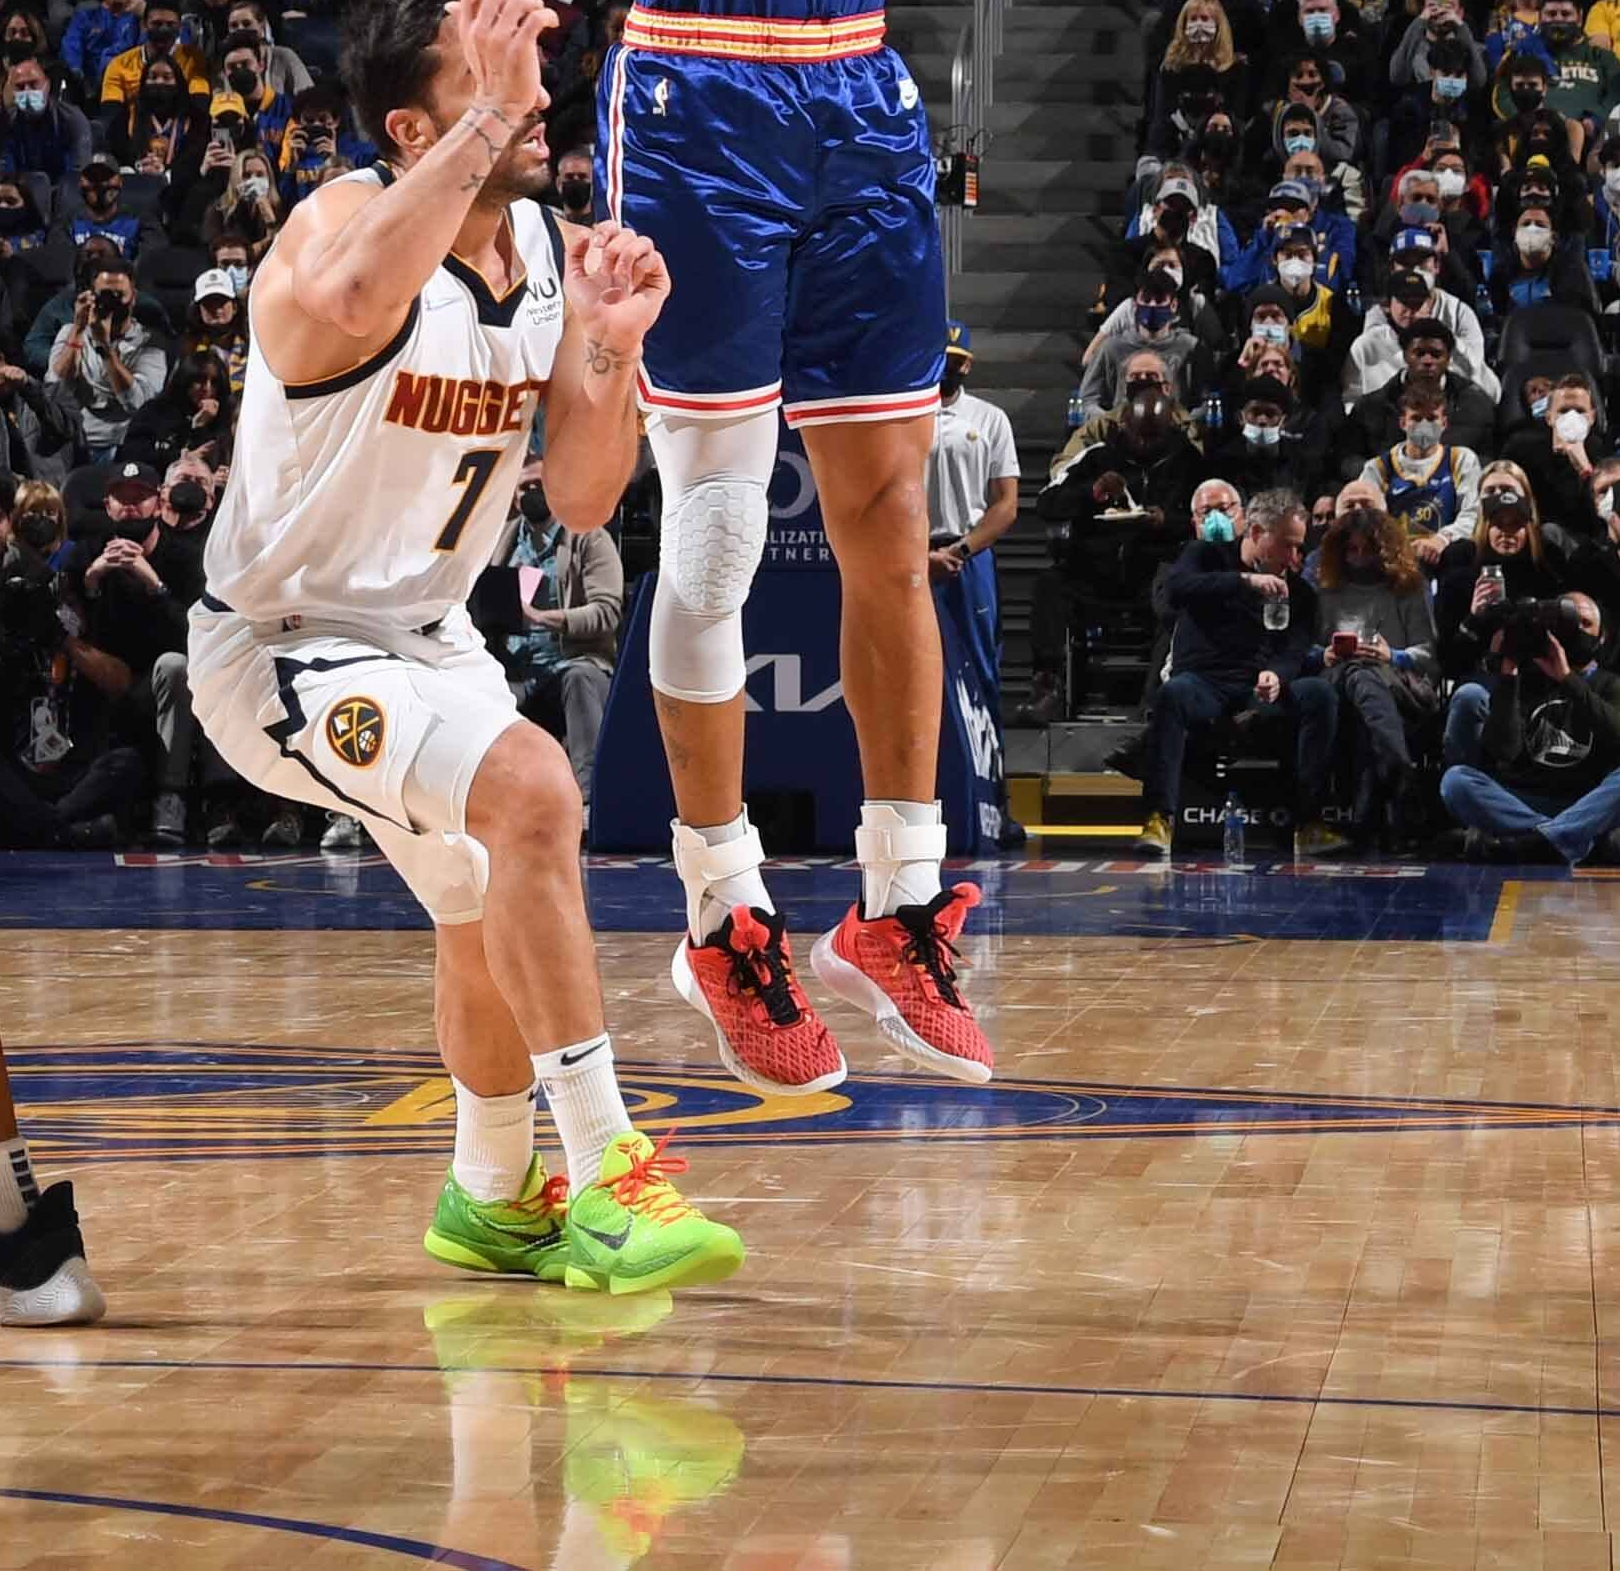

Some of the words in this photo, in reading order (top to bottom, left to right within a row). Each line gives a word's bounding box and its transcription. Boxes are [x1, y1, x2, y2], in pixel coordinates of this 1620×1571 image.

[384, 369, 550, 437] NUGGET
[430, 446, 508, 556] 7
[765, 530, 828, 545] LIZATI
[770, 547, 830, 561] TNER
